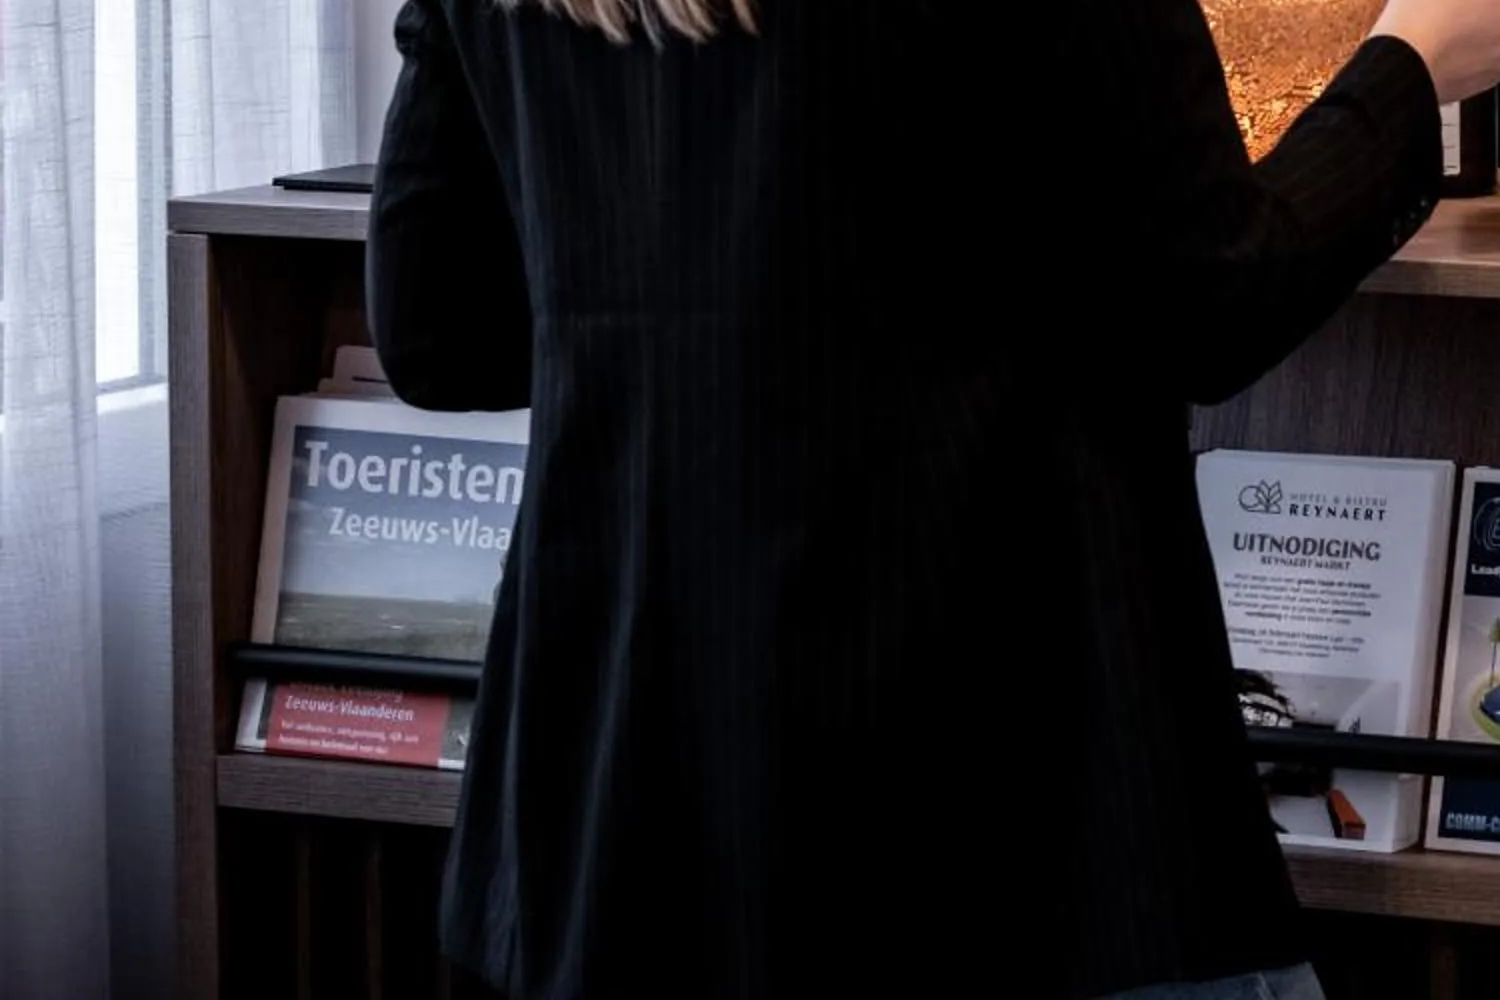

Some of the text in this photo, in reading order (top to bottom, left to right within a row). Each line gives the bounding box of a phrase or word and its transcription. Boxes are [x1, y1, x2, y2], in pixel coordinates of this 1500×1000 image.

[304, 440, 524, 505] Toeristen
[329, 507, 511, 551] Zeeuws-Vlaa
[1289, 503, 1387, 521] REYNAERT
[1232, 532, 1381, 561] UITNODIGING
